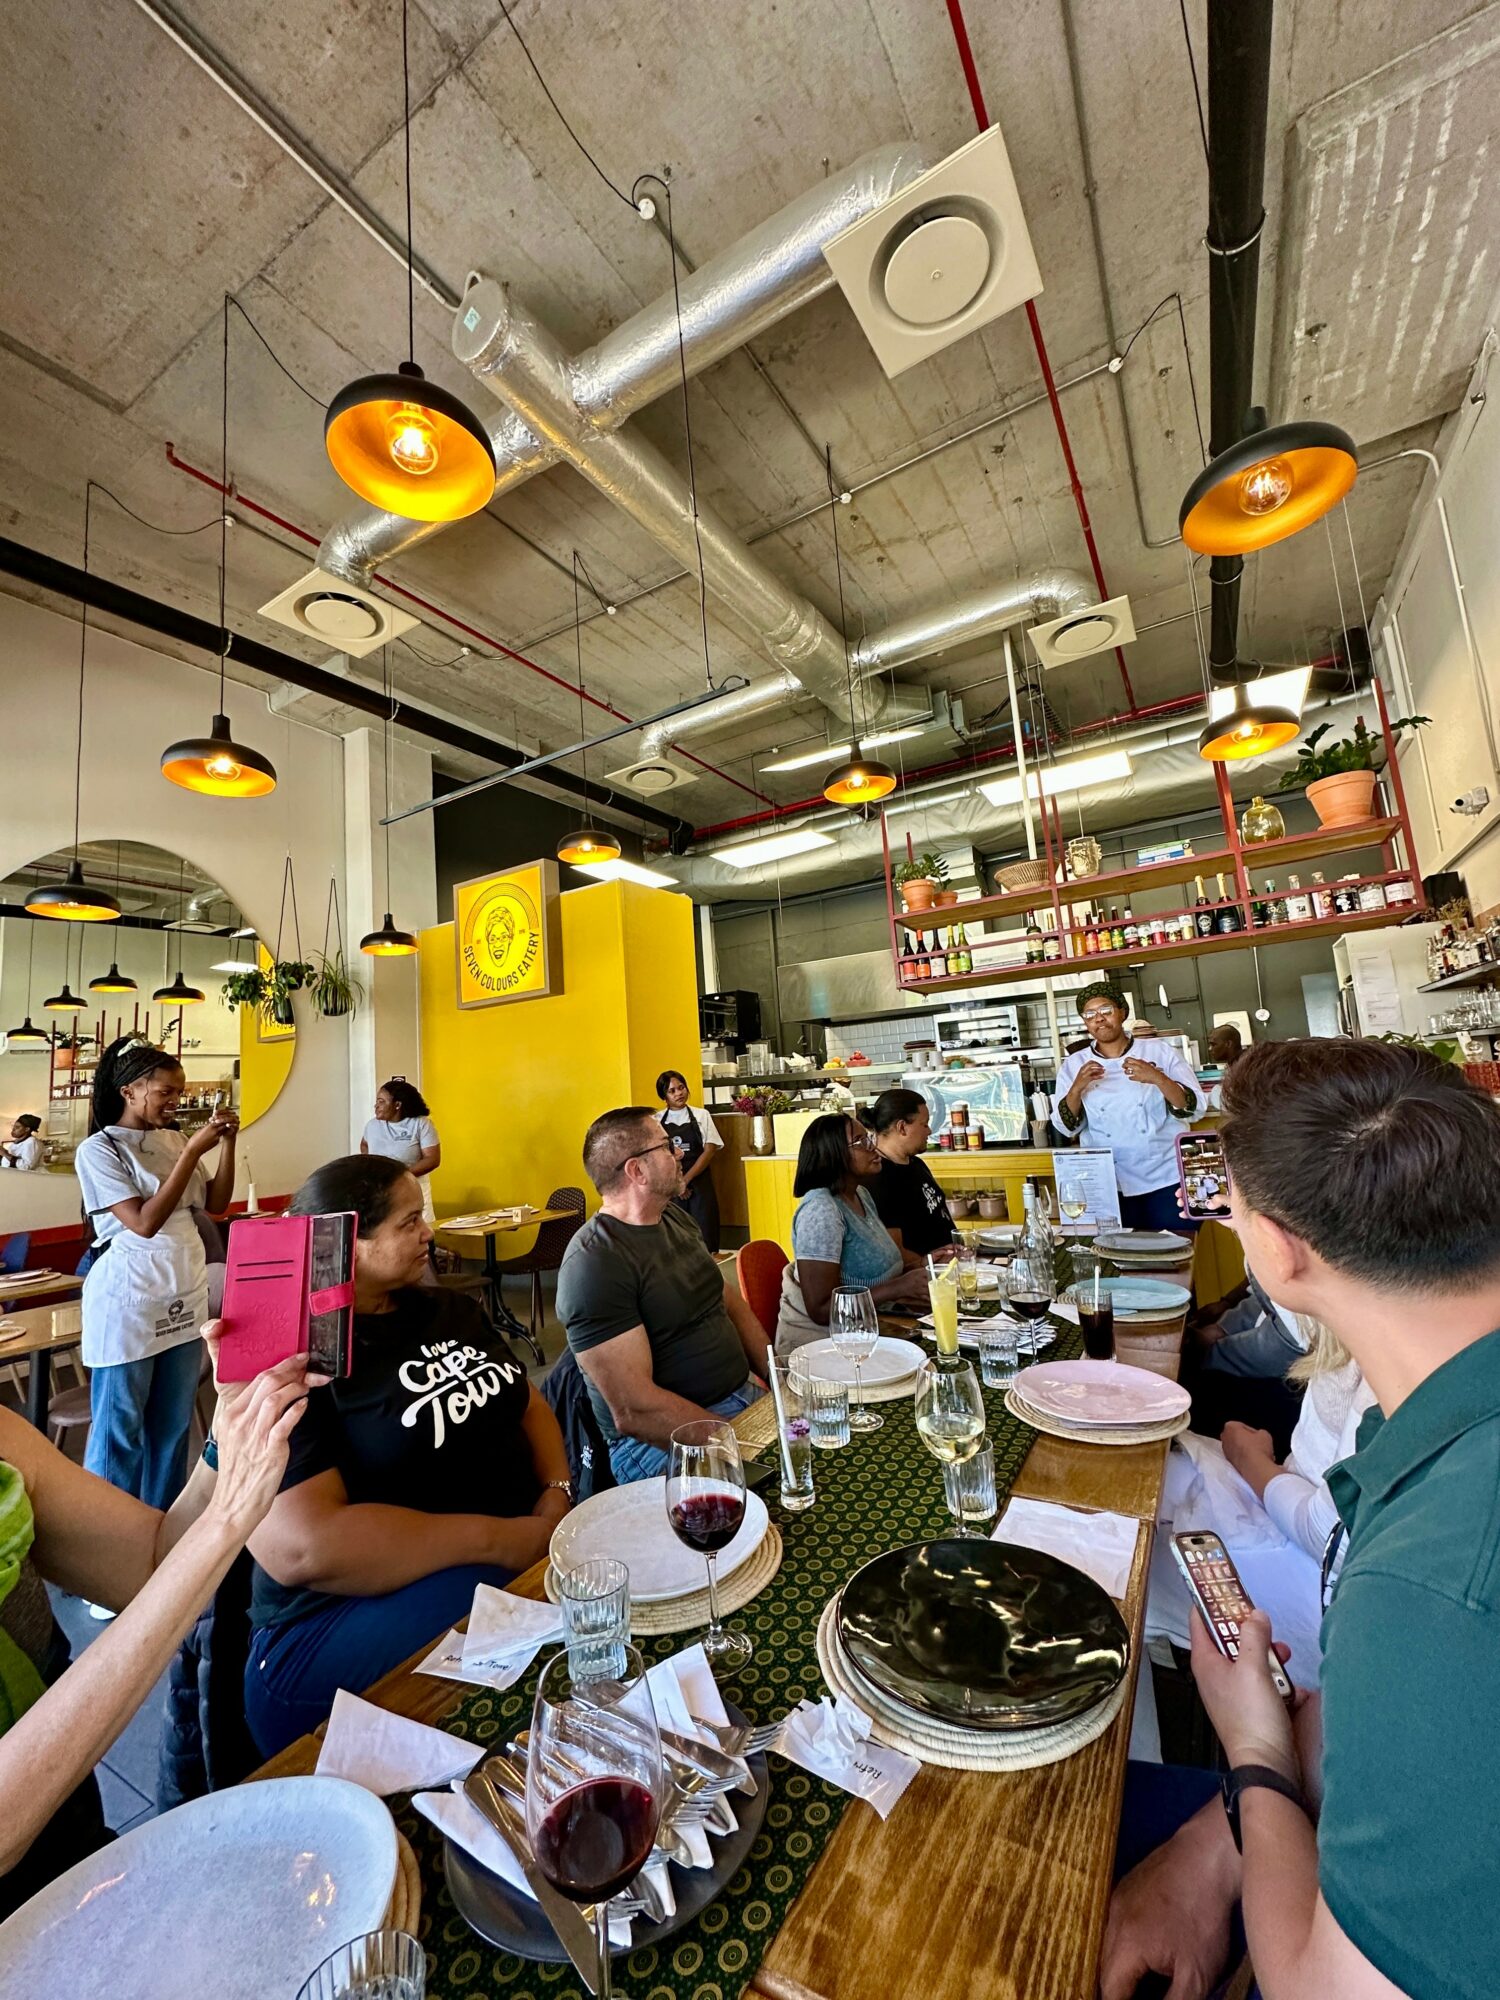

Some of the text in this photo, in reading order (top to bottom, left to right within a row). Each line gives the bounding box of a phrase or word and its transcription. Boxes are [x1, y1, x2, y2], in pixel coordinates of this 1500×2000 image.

[464, 931, 540, 991] SEVEN COLOURS EATERY
[398, 1345, 488, 1393] Cape
[420, 1340, 458, 1358] love
[401, 1361, 522, 1449] Town
